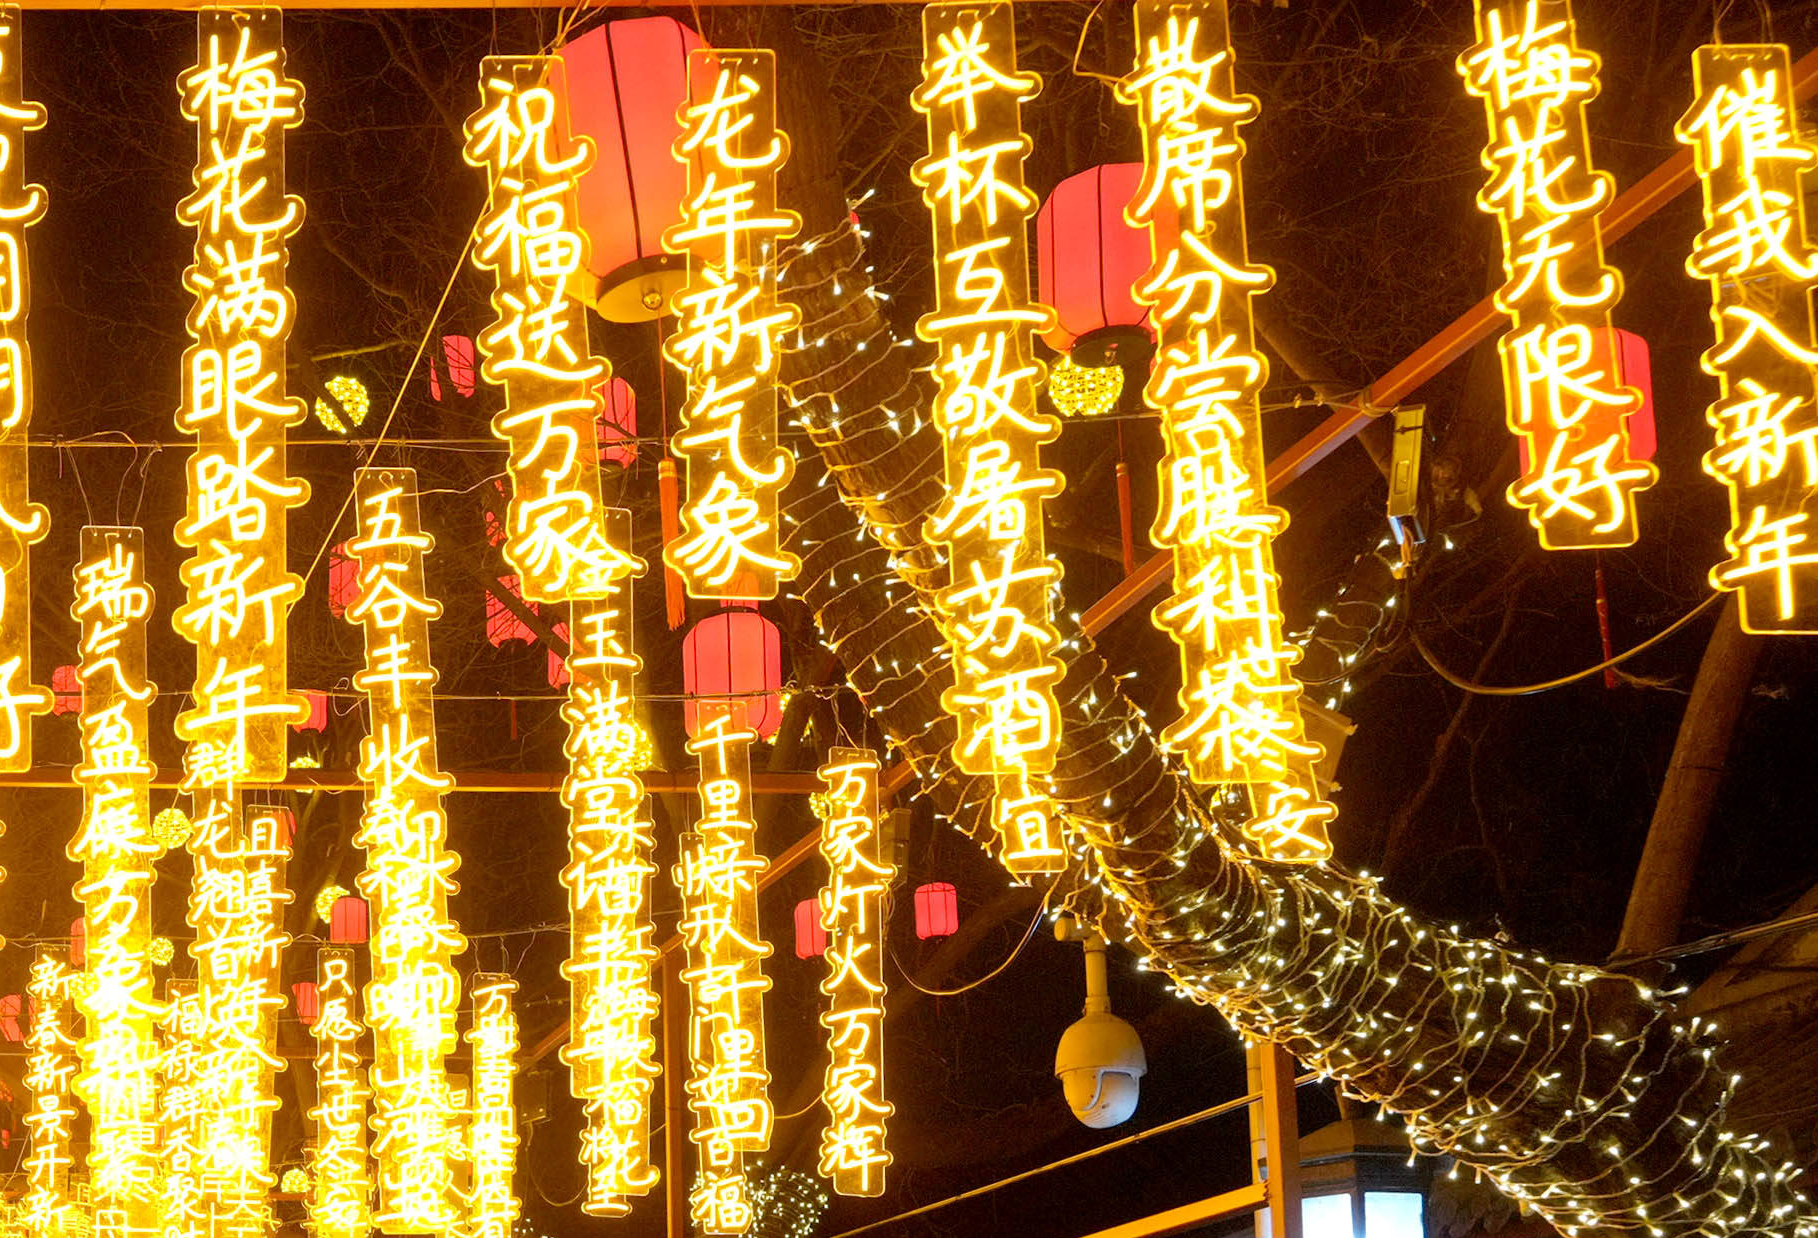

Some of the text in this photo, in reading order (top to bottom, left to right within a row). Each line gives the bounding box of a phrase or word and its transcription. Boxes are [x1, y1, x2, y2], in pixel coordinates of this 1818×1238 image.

[185, 30, 303, 772] 梅花满眼踏新年
[472, 78, 607, 592] 祝福送万家
[669, 72, 797, 585] 龙年新气象
[919, 22, 1058, 763] 举杯互敬屠苏酒
[1467, 10, 1649, 531] 梅花无限好
[1682, 68, 1818, 621] 催我入新年
[823, 764, 893, 1192] 万家灯火万家辉
